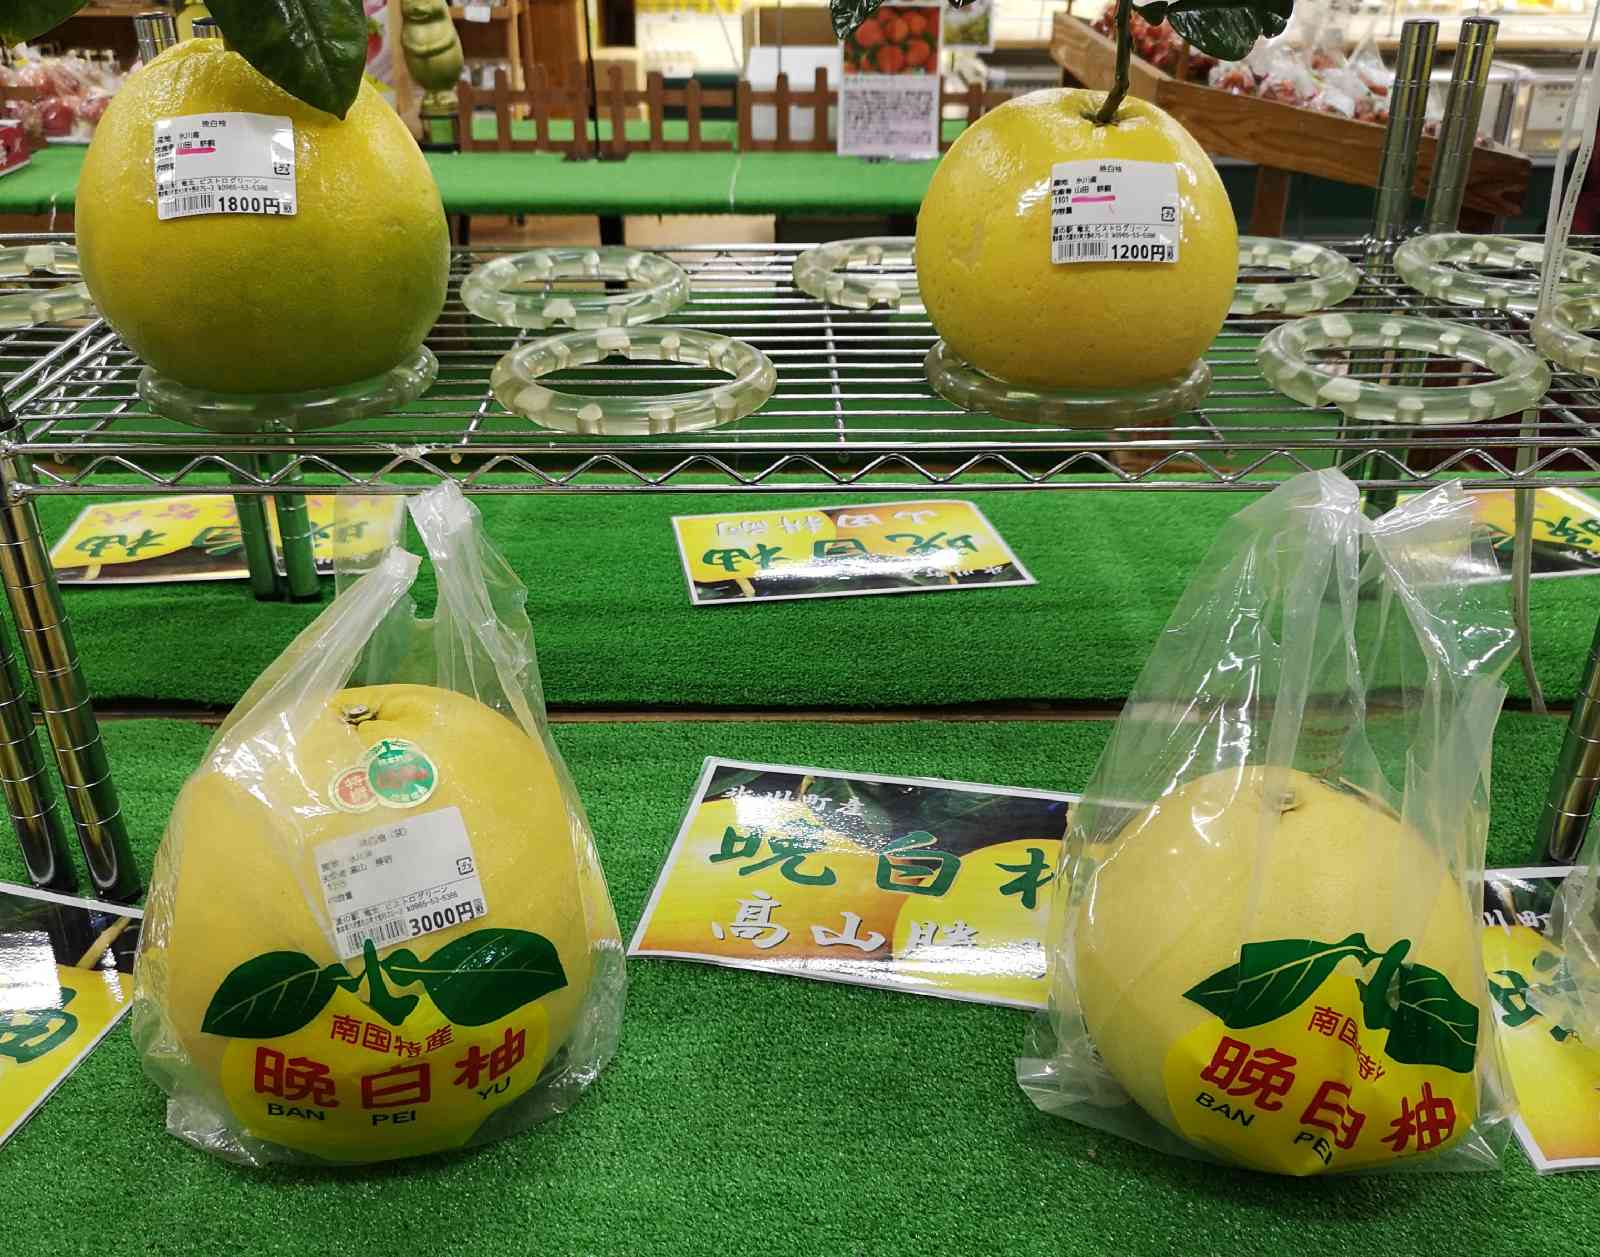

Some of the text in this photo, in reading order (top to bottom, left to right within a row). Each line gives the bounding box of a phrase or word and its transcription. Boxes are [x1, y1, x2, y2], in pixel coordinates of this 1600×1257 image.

[217, 196, 281, 214] 1800円
[1111, 244, 1166, 261] 1200円
[408, 900, 476, 937] 3000円
[330, 1013, 455, 1058] 南国特産
[253, 1027, 527, 1110] 晩白柚
[266, 1076, 512, 1128] BAN PEI YU
[1200, 1035, 1457, 1153] 晩白柚
[1194, 1091, 1335, 1166] BAN PEI
